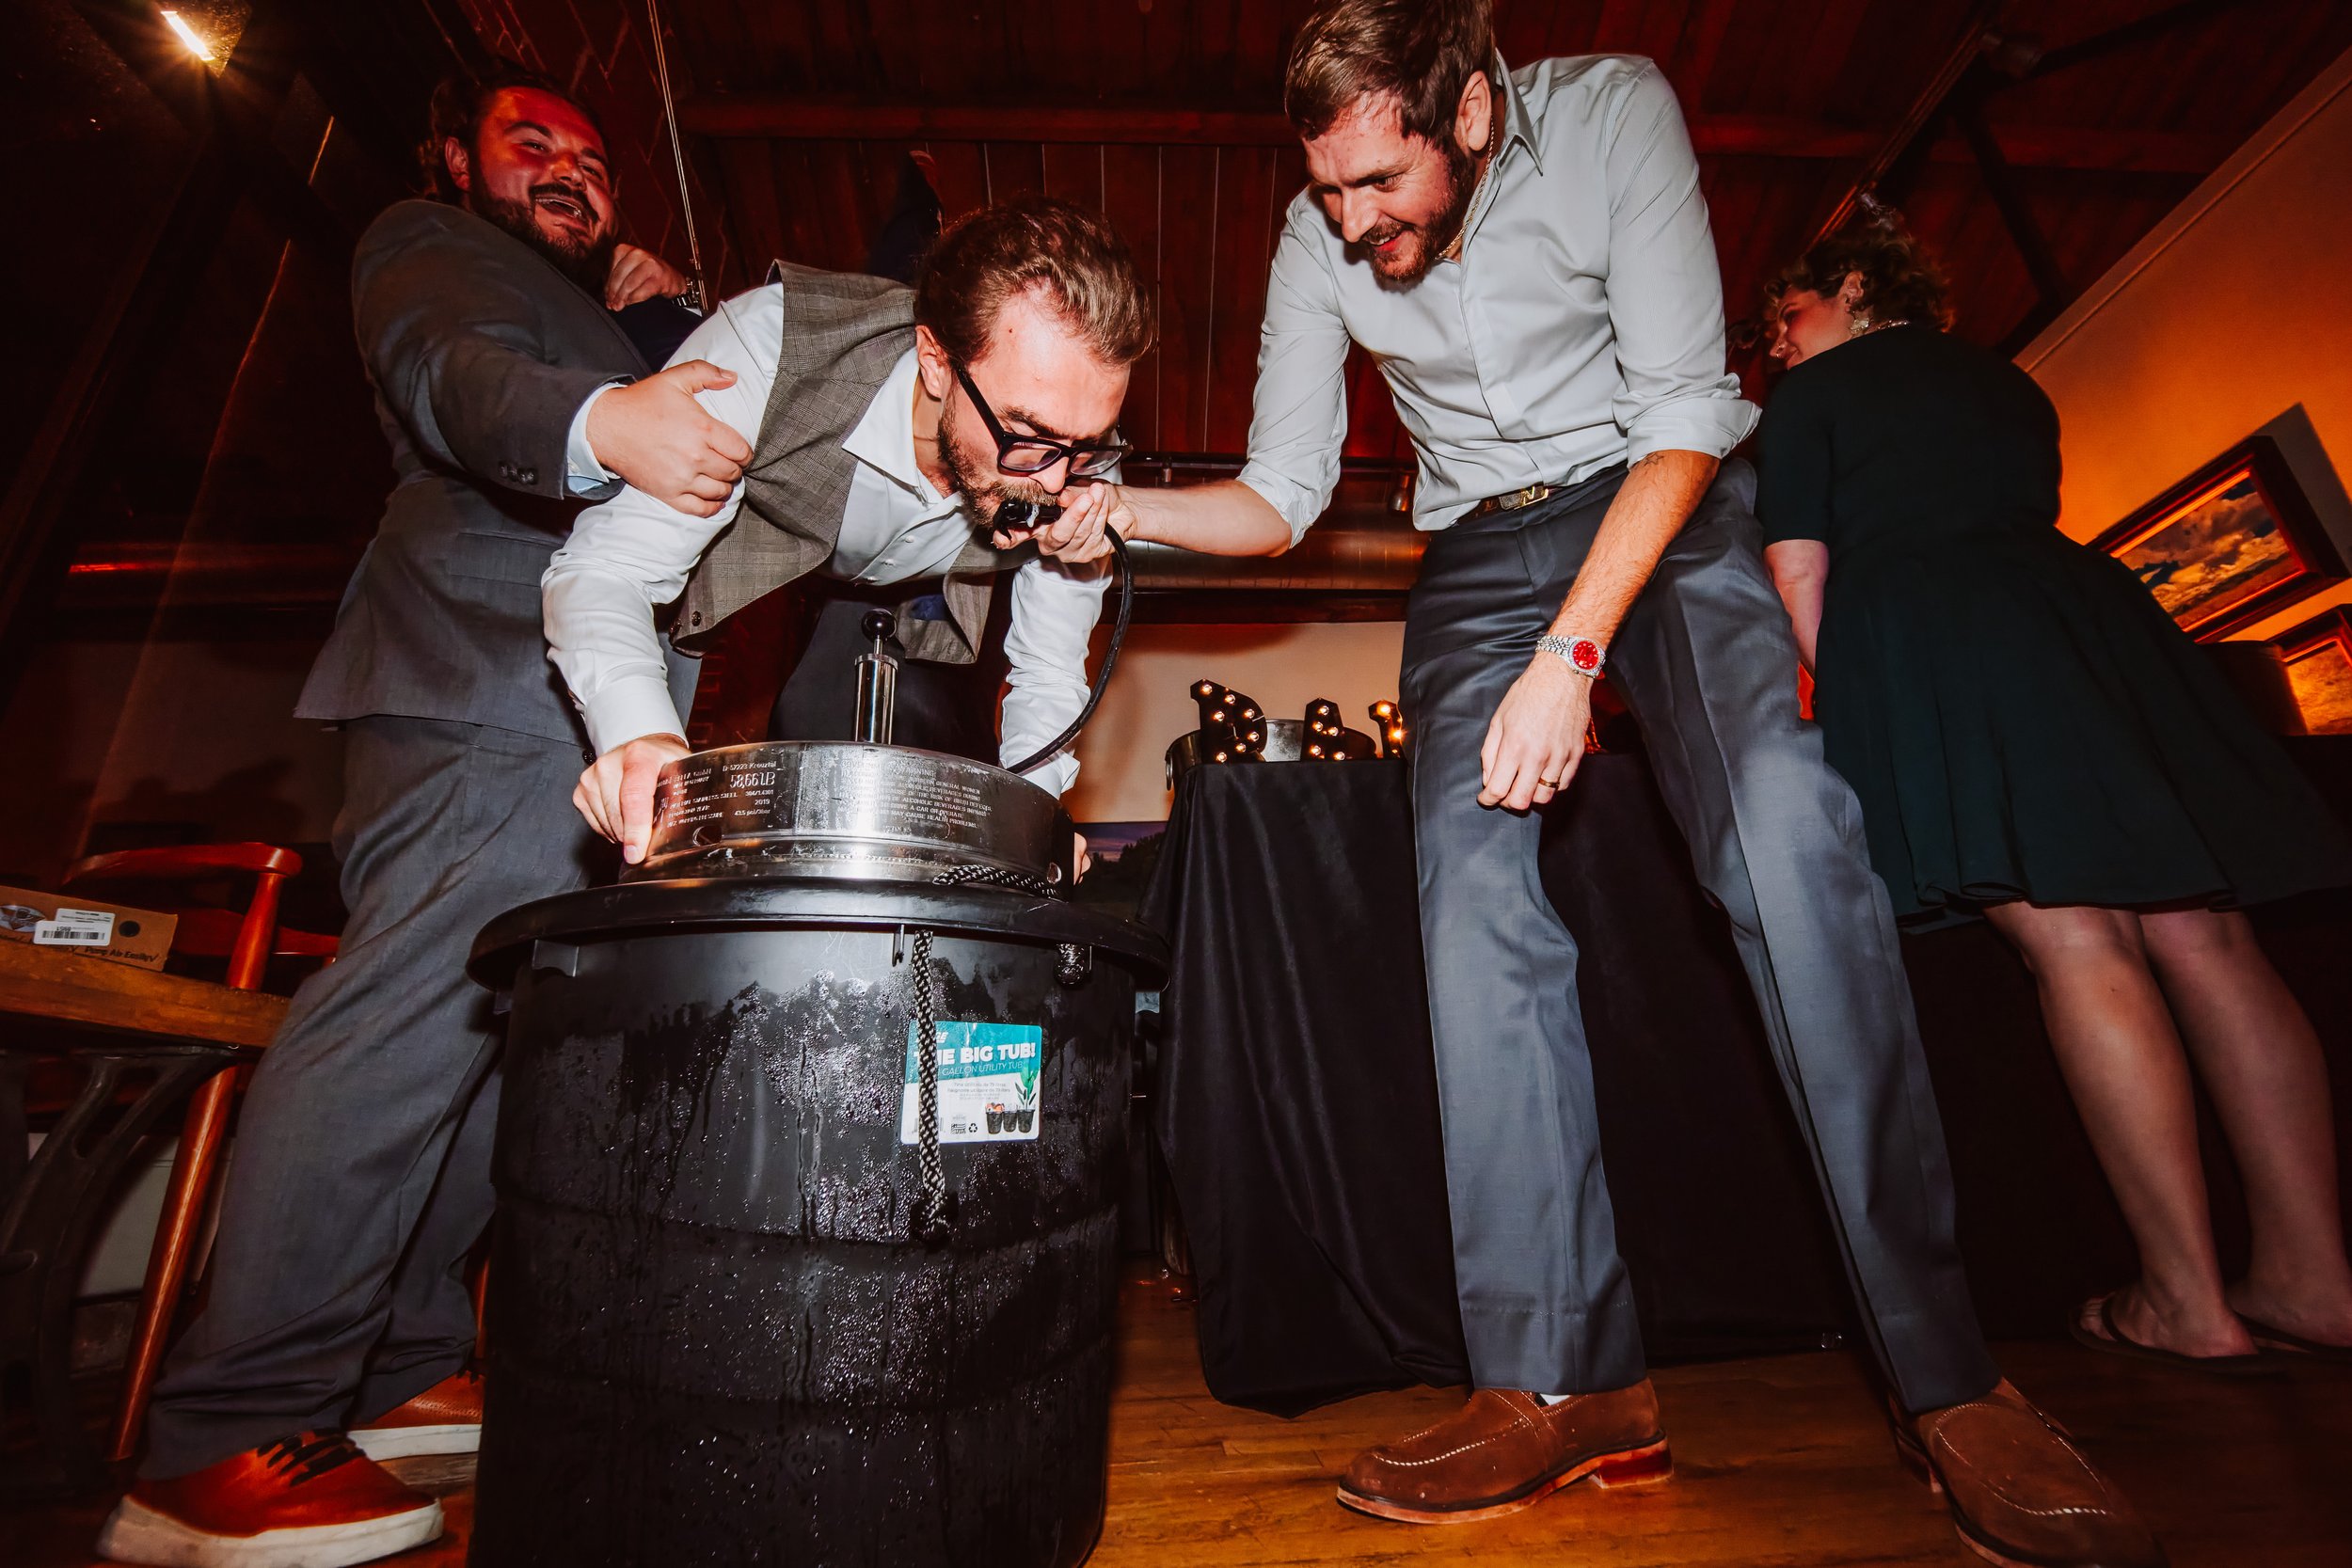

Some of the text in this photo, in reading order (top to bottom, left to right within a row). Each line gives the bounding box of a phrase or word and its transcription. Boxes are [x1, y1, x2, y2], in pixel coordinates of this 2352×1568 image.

[935, 781, 960, 789] GENERAL
[933, 801, 966, 812] BEVERAGES
[960, 1045, 993, 1064] BIG
[997, 1042, 1036, 1060] TUB!
[942, 1060, 1024, 1076] GALLON UTILITY TUB
